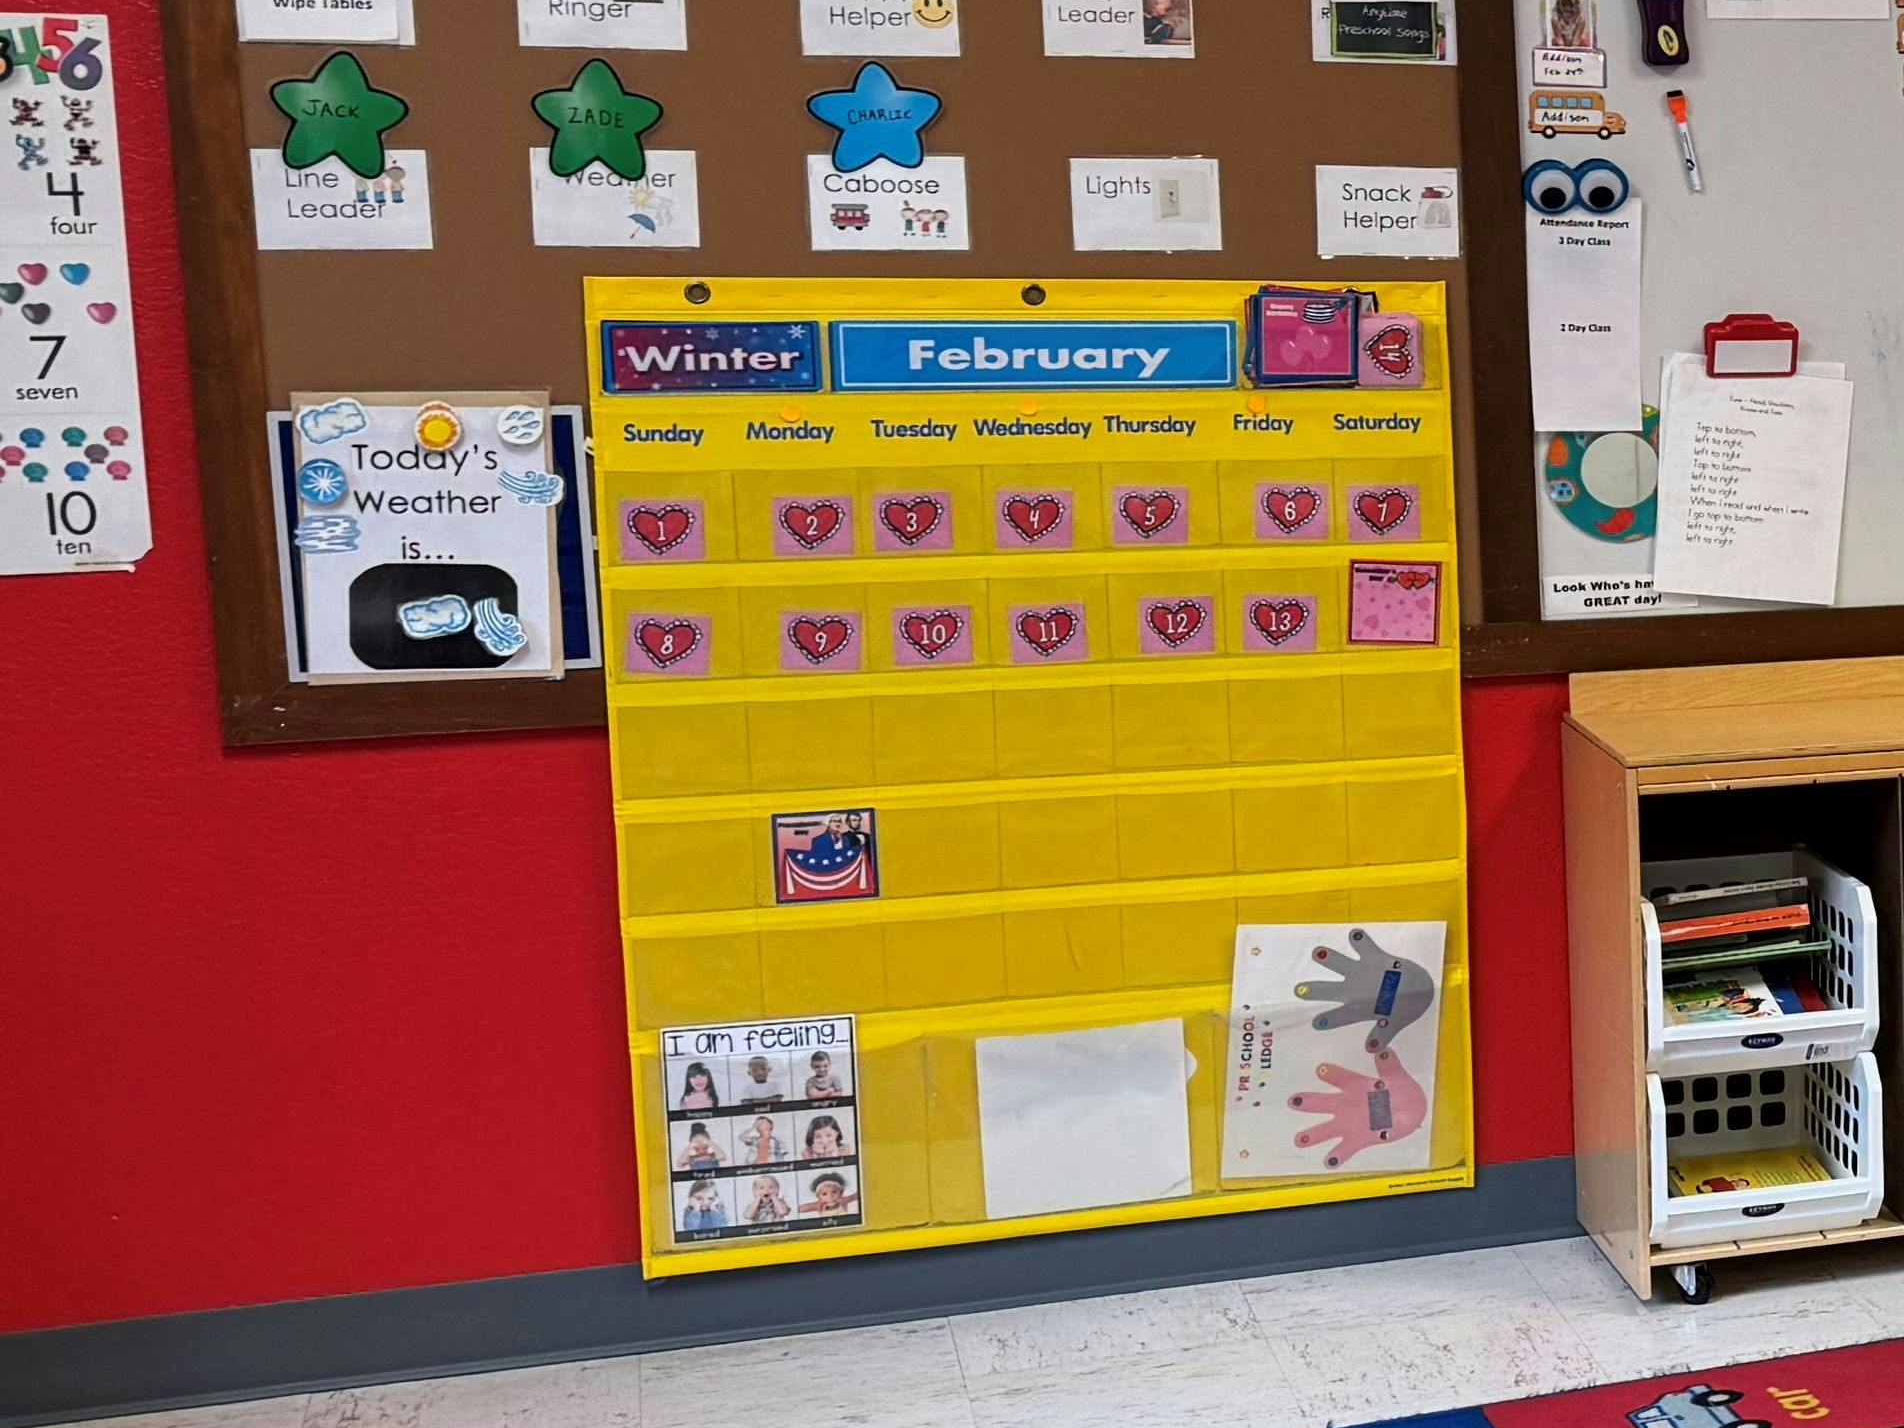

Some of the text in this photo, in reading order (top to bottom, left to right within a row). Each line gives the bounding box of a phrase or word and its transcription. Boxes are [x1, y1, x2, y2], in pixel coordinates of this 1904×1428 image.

[829, 7, 911, 28] Helper
[1058, 4, 1136, 25] Leader
[301, 99, 360, 119] JACK
[568, 107, 624, 128] ZADE
[824, 174, 940, 195] Caboose
[1086, 175, 1151, 198] Lights
[1341, 182, 1412, 204] Snack
[287, 198, 386, 220] Leader
[49, 216, 97, 236] four
[1343, 210, 1417, 231] Helper
[1567, 237, 1611, 247] Day Class
[1568, 324, 1611, 333] Day Class
[29, 335, 67, 380] 7
[625, 342, 801, 376] Winter
[908, 339, 1171, 380] February
[16, 383, 79, 402] seven
[746, 420, 835, 445] Monday
[871, 418, 959, 441] Tuesday
[973, 415, 1093, 440] Wednesday
[1103, 413, 1197, 438] Thursday
[1232, 413, 1294, 437] Friday
[1333, 412, 1422, 434] Saturday
[623, 422, 705, 448] Sunday
[352, 444, 499, 475] Today's
[354, 489, 503, 515] Weather
[46, 491, 97, 537] 10
[56, 537, 92, 556] ten
[1553, 580, 1631, 594] Look Who's
[1583, 592, 1662, 608] GREAT day!
[1165, 612, 1189, 636] 12
[1268, 611, 1294, 633] 13
[920, 624, 947, 646] 10
[667, 1031, 734, 1057] I am
[1764, 1384, 1830, 1420] car
